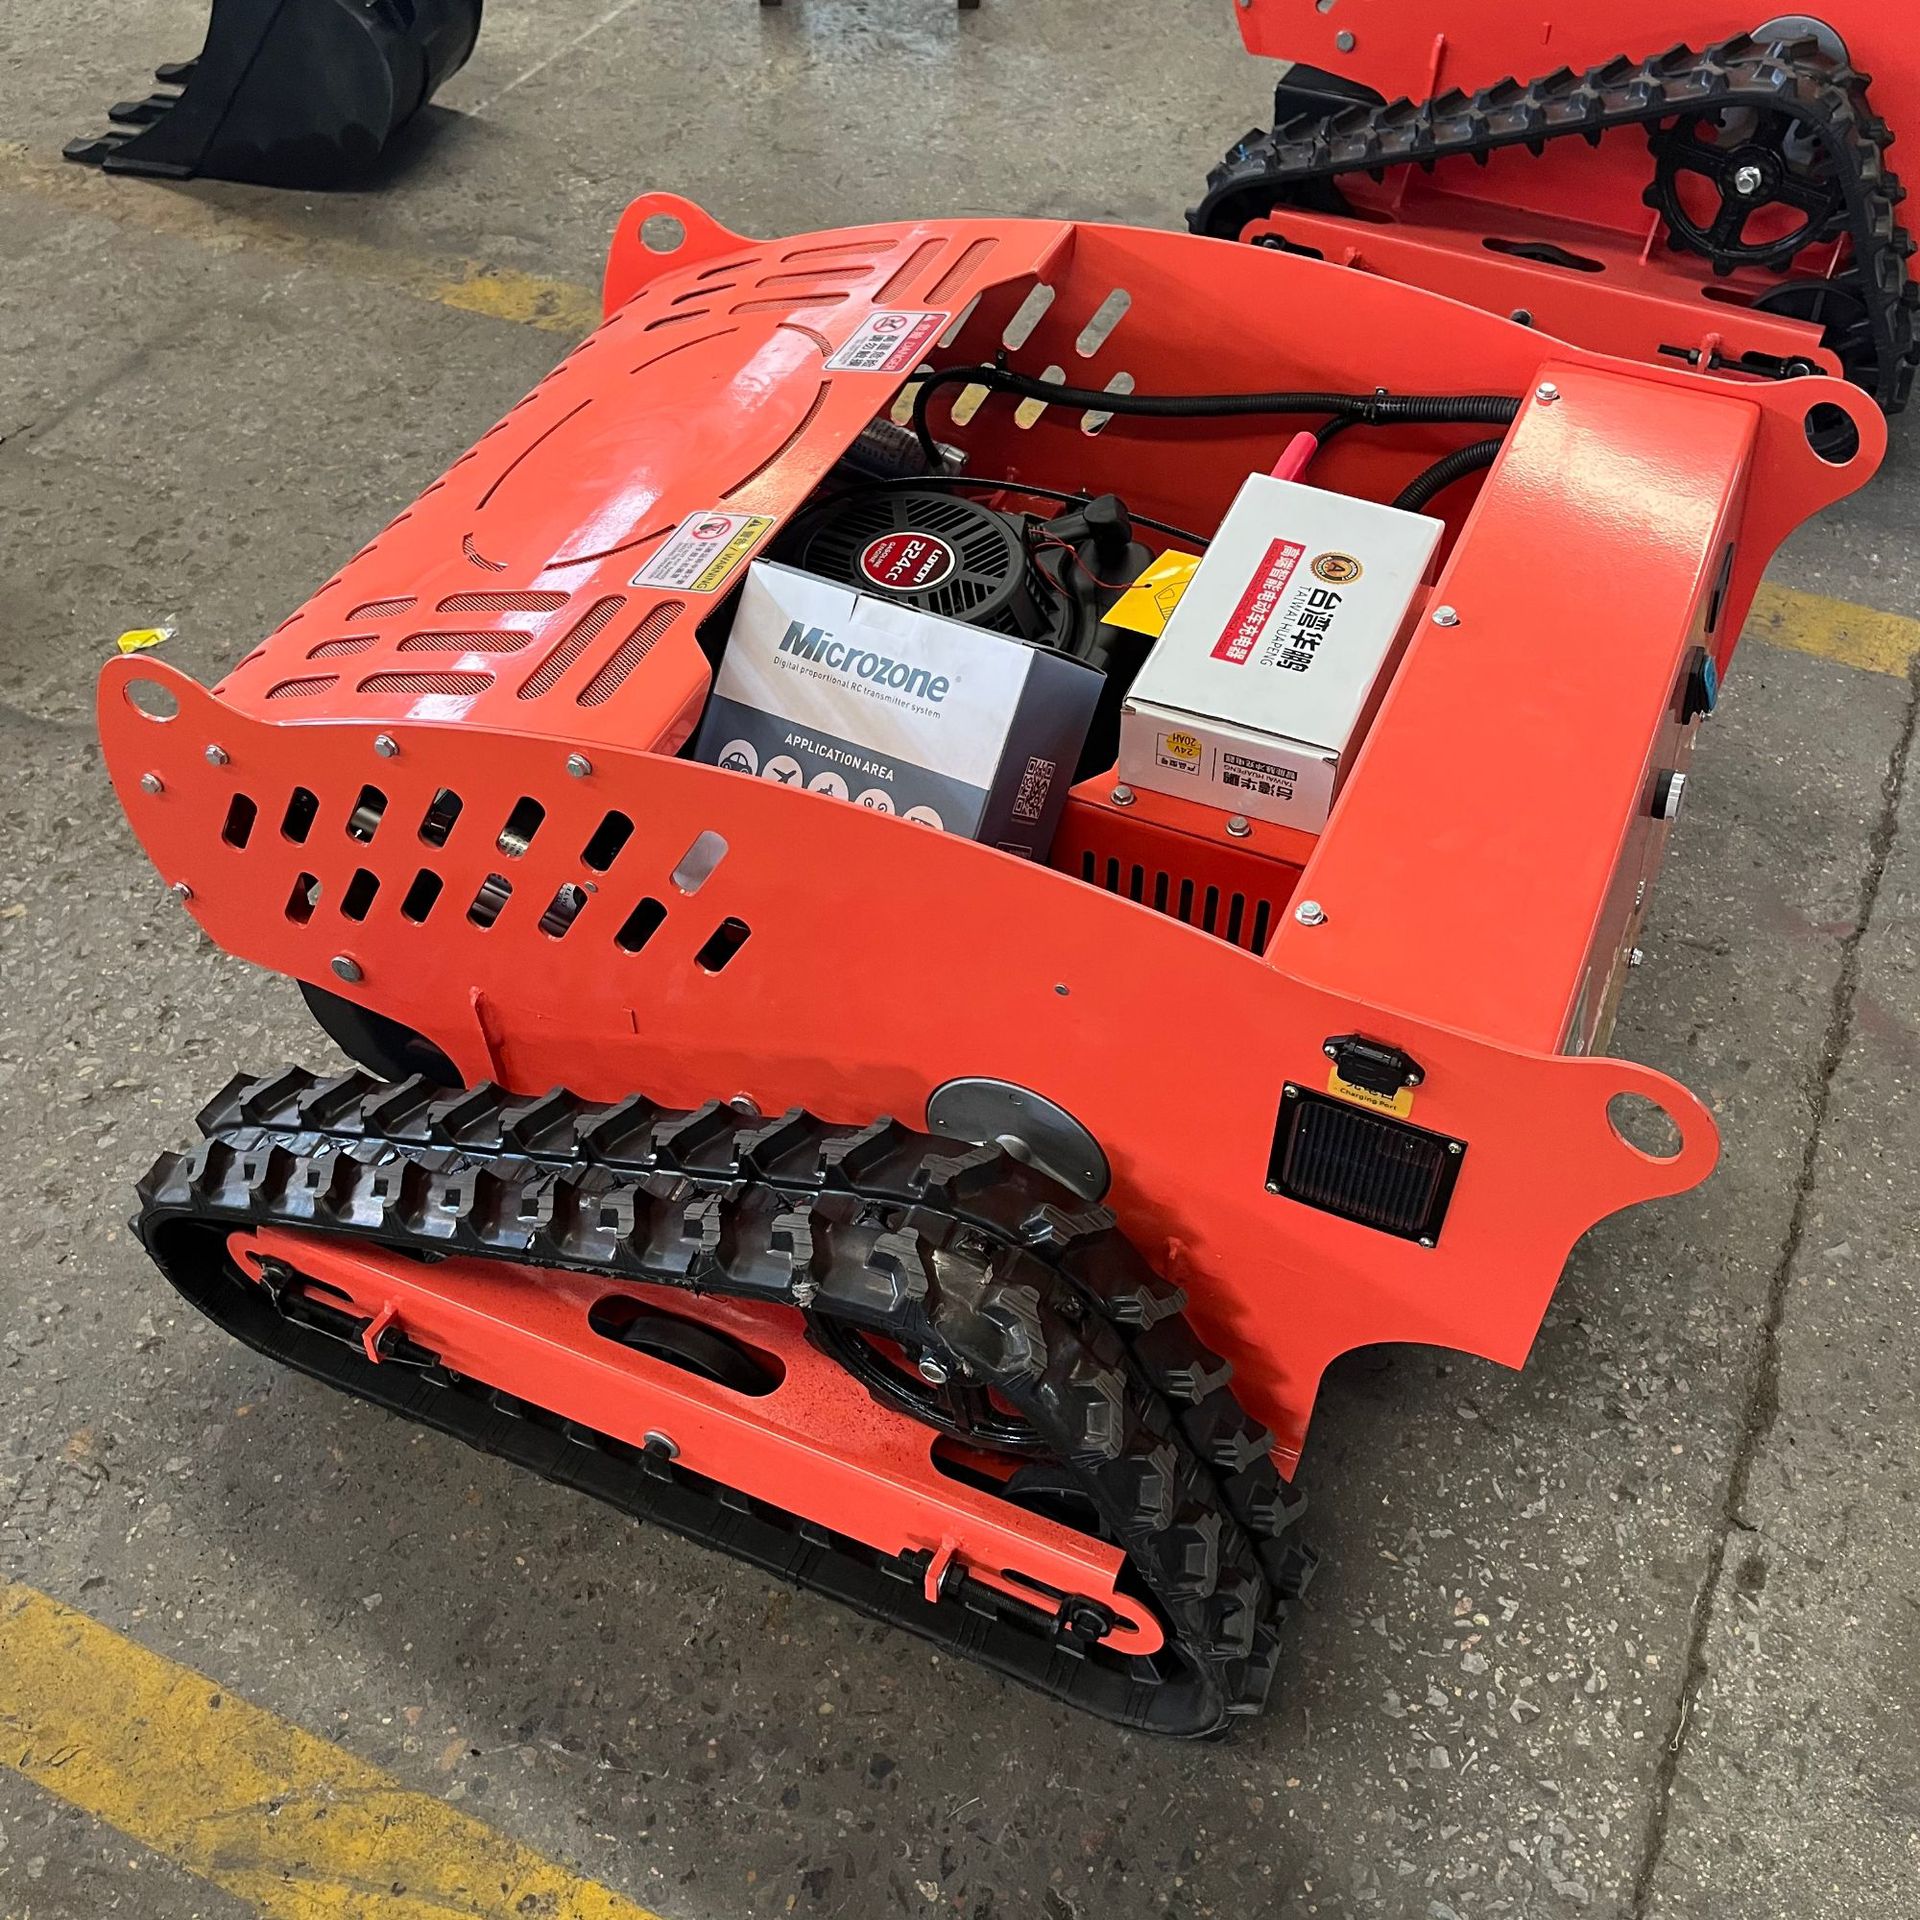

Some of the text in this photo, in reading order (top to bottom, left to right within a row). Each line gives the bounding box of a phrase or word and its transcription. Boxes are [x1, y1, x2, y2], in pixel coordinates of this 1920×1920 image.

[885, 342, 916, 370] DANGER
[868, 543, 887, 563] ENGINE
[873, 541, 896, 568] GASOLINE
[697, 552, 736, 589] WARNING
[1226, 545, 1300, 660] 高端智能电动车充电器
[1260, 622, 1293, 667] HUAPENG
[778, 620, 950, 702] Microzone
[773, 656, 941, 719] Digital proportional RC transmitter system
[1173, 733, 1197, 747] 20AH
[1174, 746, 1193, 756] 24V
[785, 733, 894, 781] APPLICATION AREA
[1224, 764, 1264, 779] HUAPENG
[1340, 1088, 1378, 1105] Charging
[1379, 1100, 1397, 1110] Port
